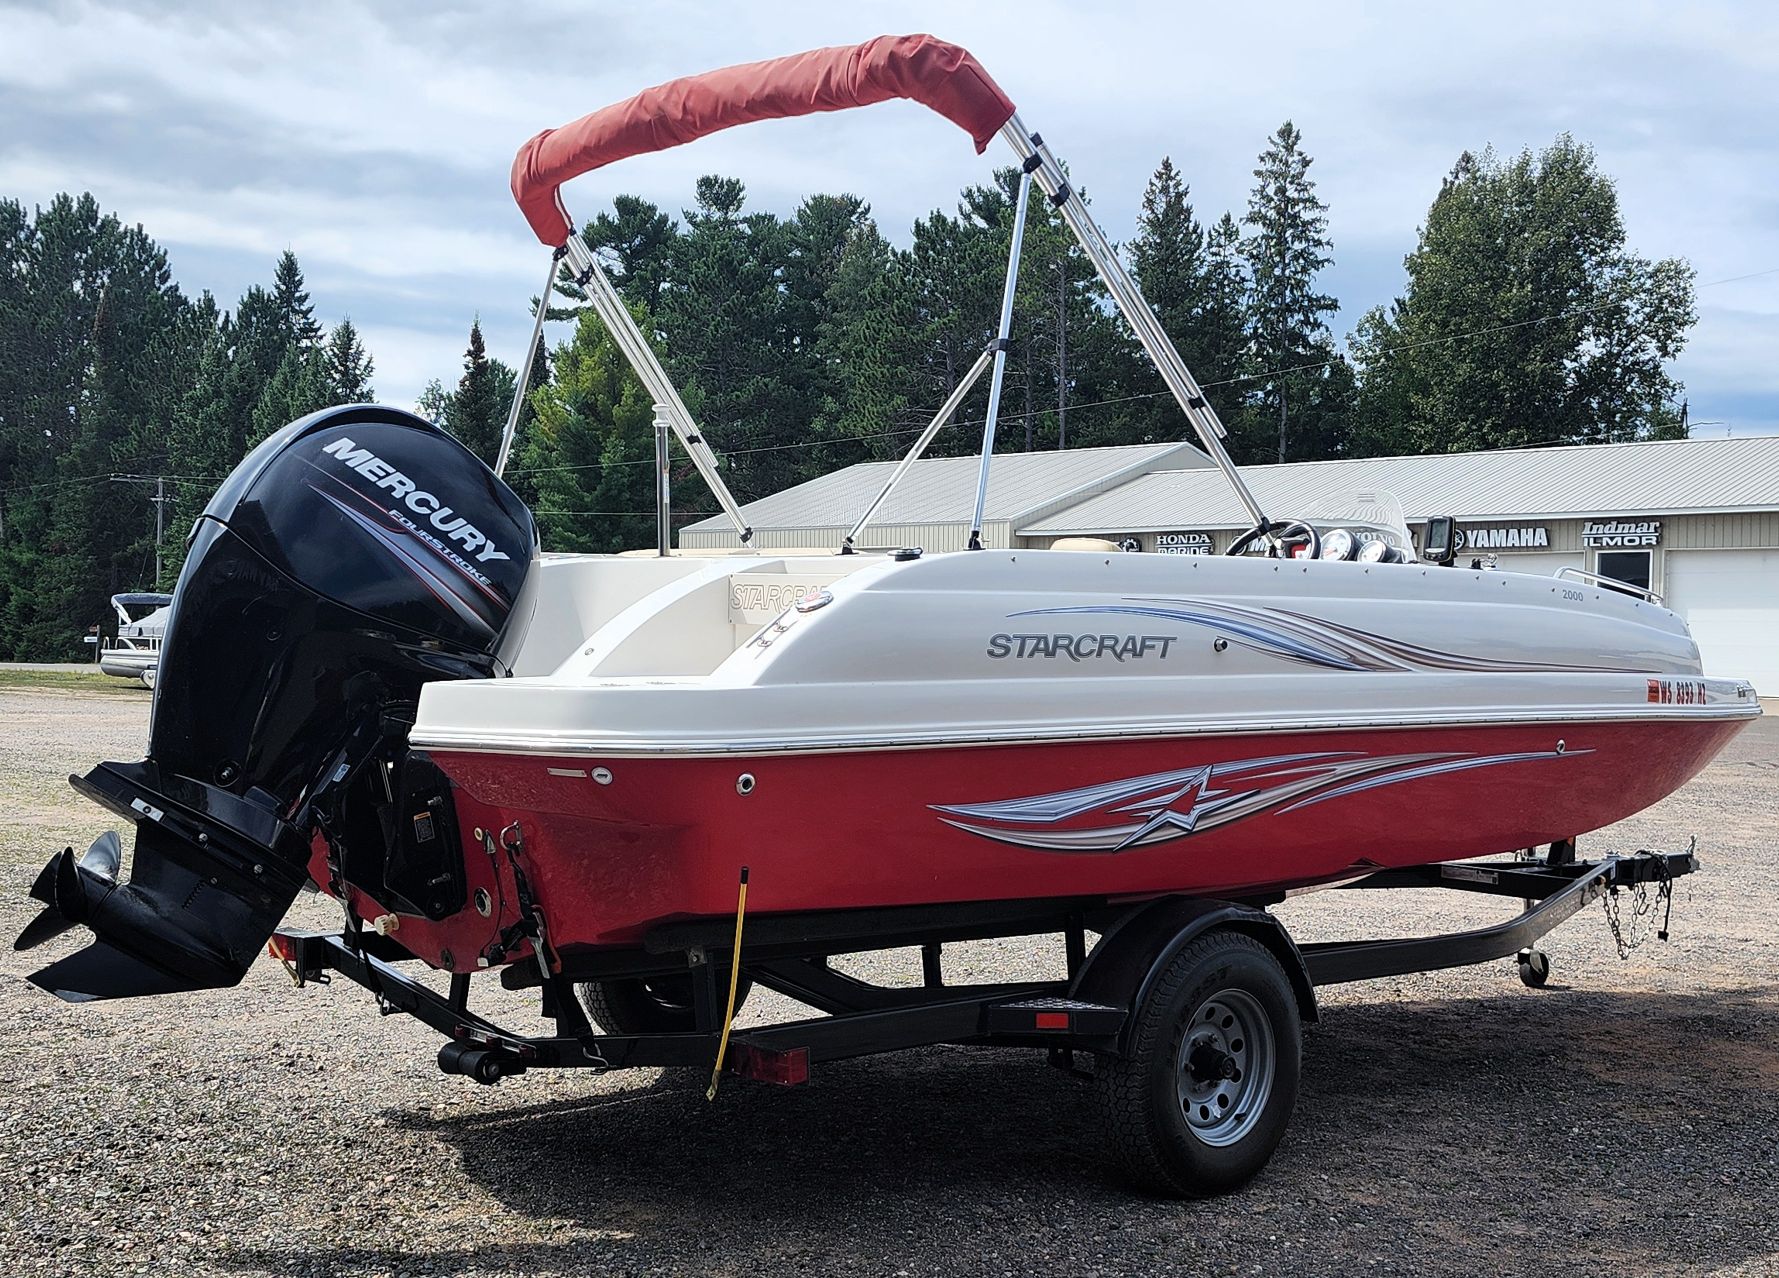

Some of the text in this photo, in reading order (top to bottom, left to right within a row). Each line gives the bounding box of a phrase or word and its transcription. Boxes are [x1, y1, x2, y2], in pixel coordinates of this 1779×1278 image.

[321, 437, 511, 564] MERCURY
[1582, 522, 1660, 534] Indmar
[1156, 533, 1211, 545] HONDA
[1466, 527, 1548, 548] YAMAHA
[1583, 536, 1658, 547] ILMOR
[388, 509, 493, 586] FOURSTROKE
[1562, 589, 1584, 601] 2000
[987, 633, 1177, 662] STARCRAFT
